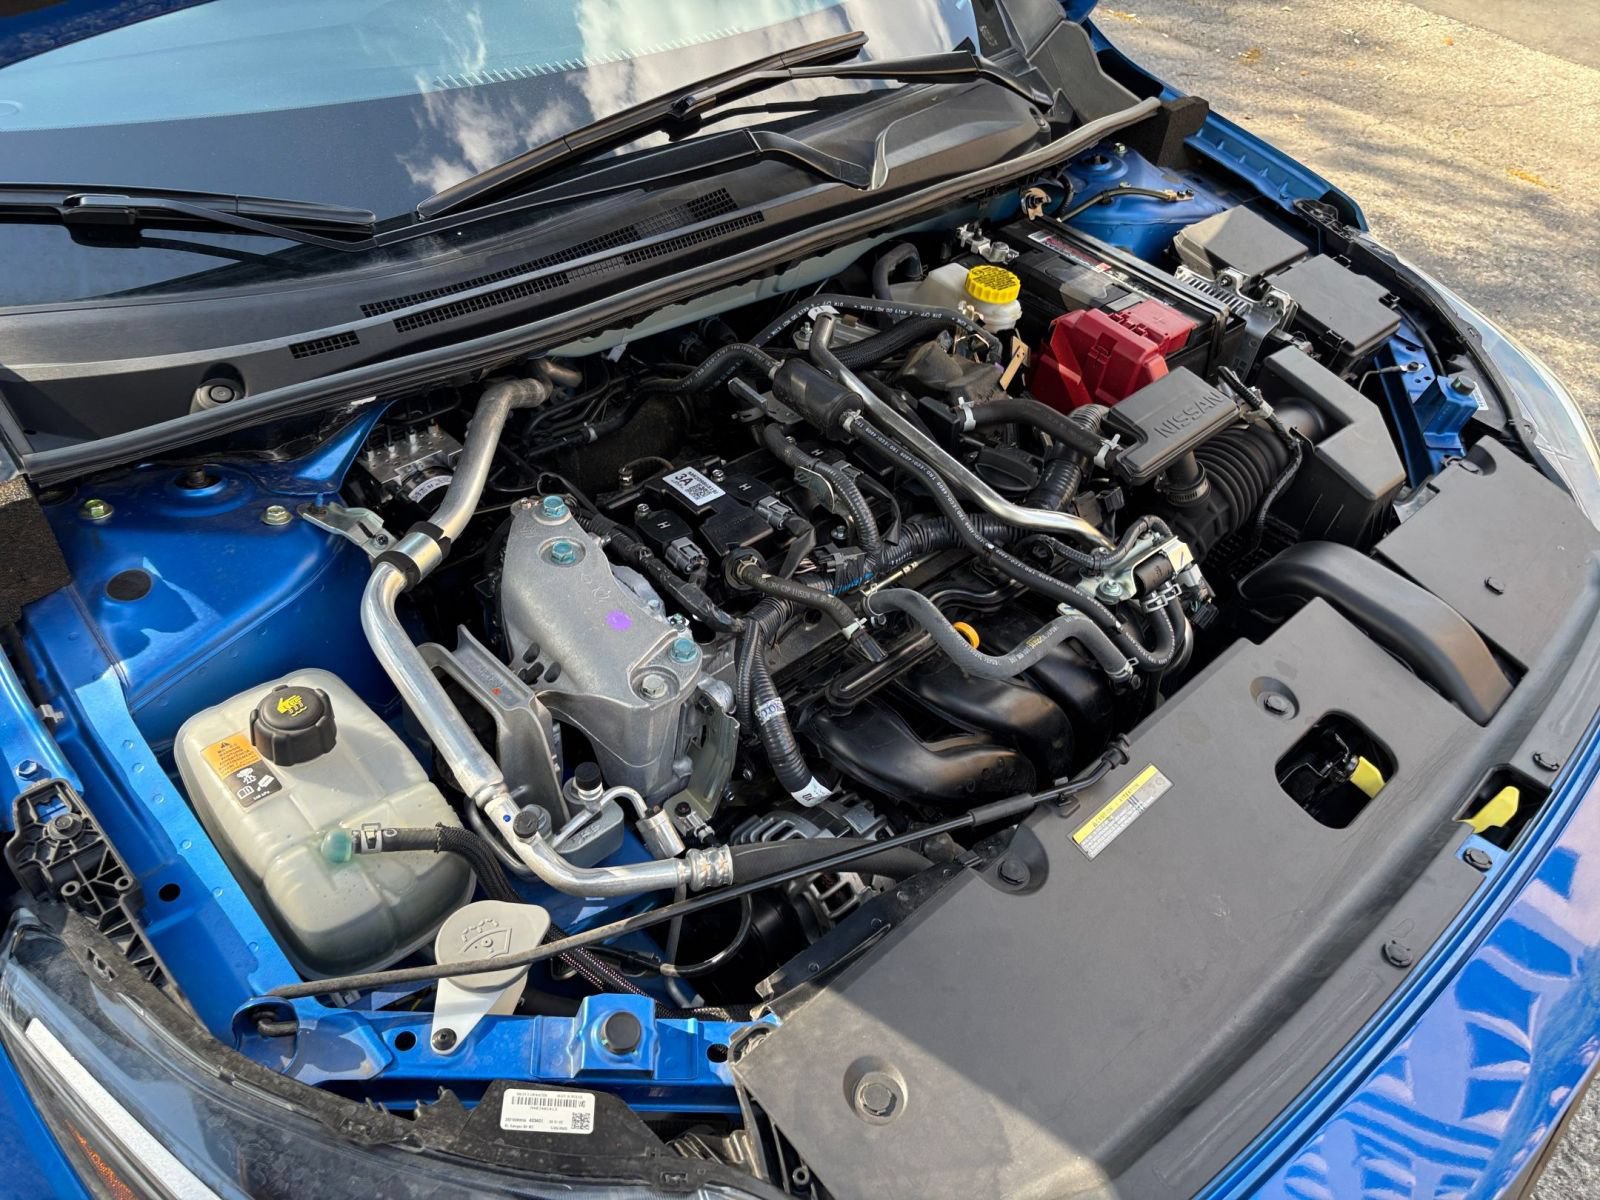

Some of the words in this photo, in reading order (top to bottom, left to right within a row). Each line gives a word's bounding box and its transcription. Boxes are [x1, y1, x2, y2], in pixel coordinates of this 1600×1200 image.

[1153, 391, 1223, 439] NISSAN
[810, 448, 824, 456] H
[674, 473, 694, 487] 3A
[739, 482, 752, 491] H
[656, 520, 672, 529] H
